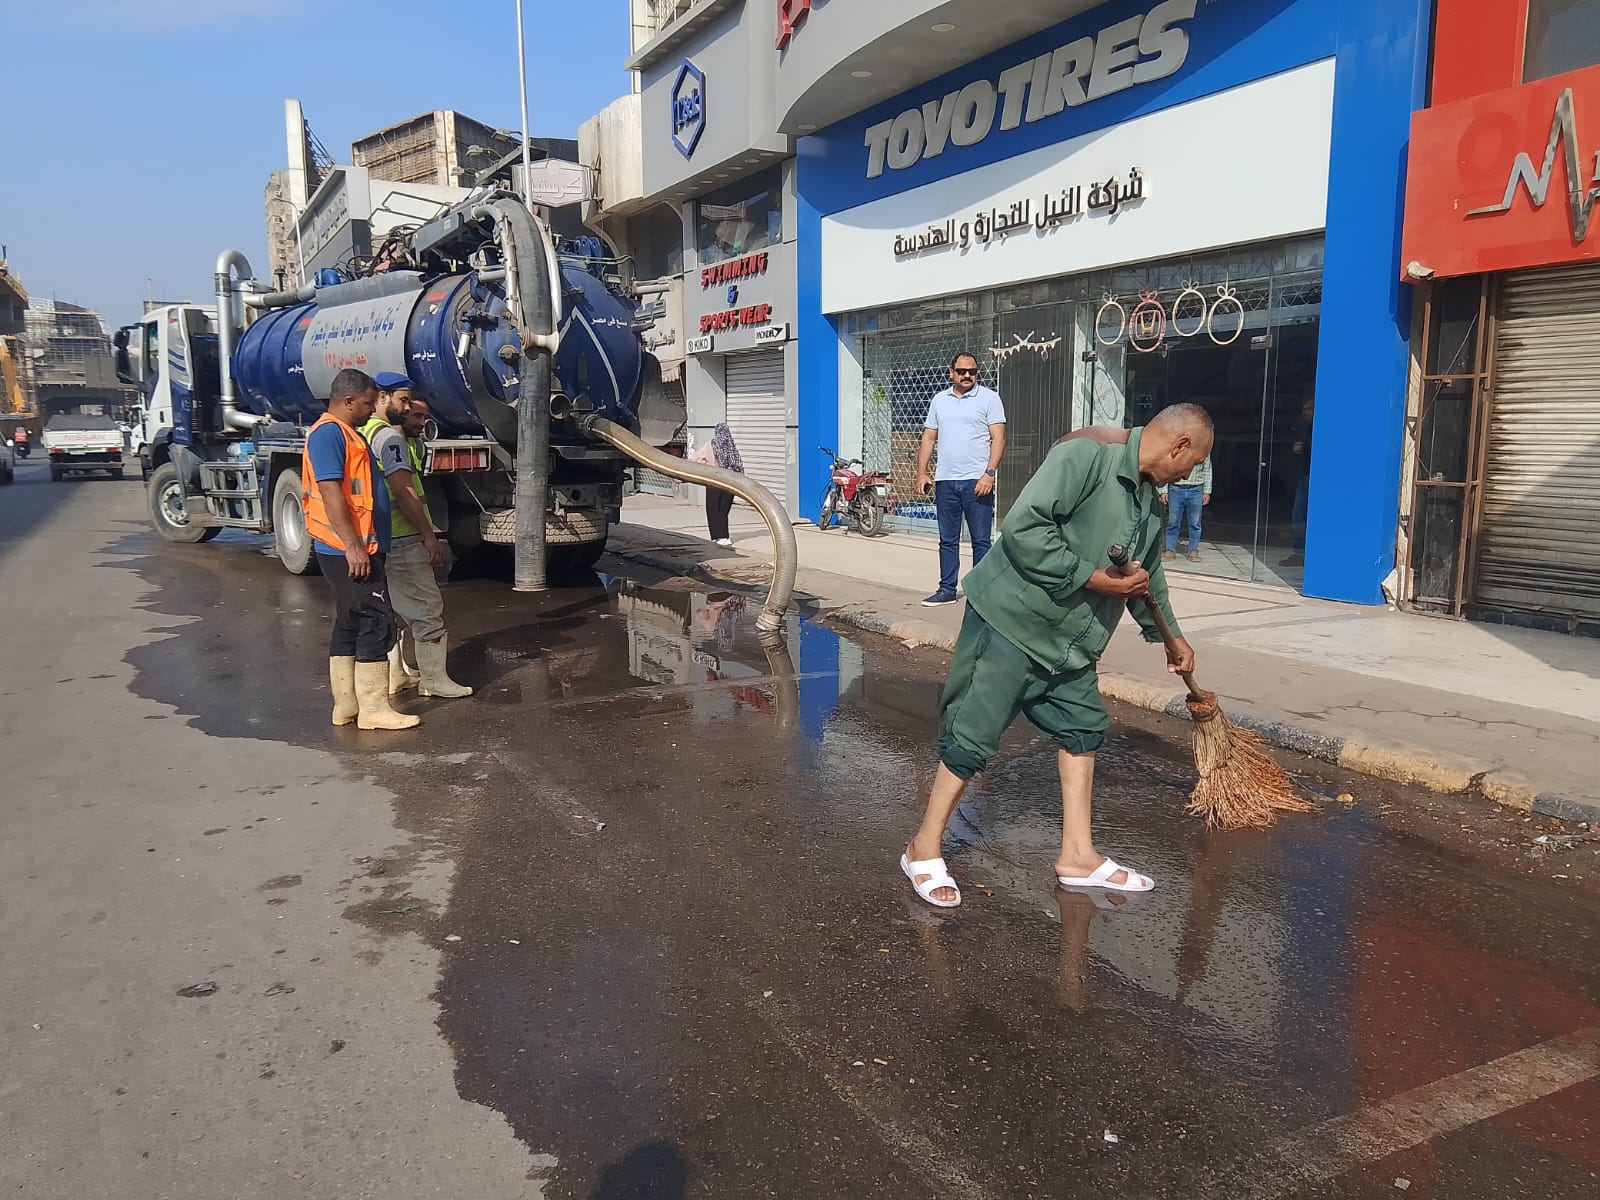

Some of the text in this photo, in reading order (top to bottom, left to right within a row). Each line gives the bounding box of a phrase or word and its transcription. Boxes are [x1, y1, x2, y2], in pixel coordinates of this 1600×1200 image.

[864, 0, 1198, 179] TOYO TIRES
[893, 166, 1143, 257] شركة النيل للتجارة و الهندسة
[700, 252, 767, 287] SWIMMING
[700, 303, 770, 333] SPORTS WEAR
[388, 444, 403, 463] 7
